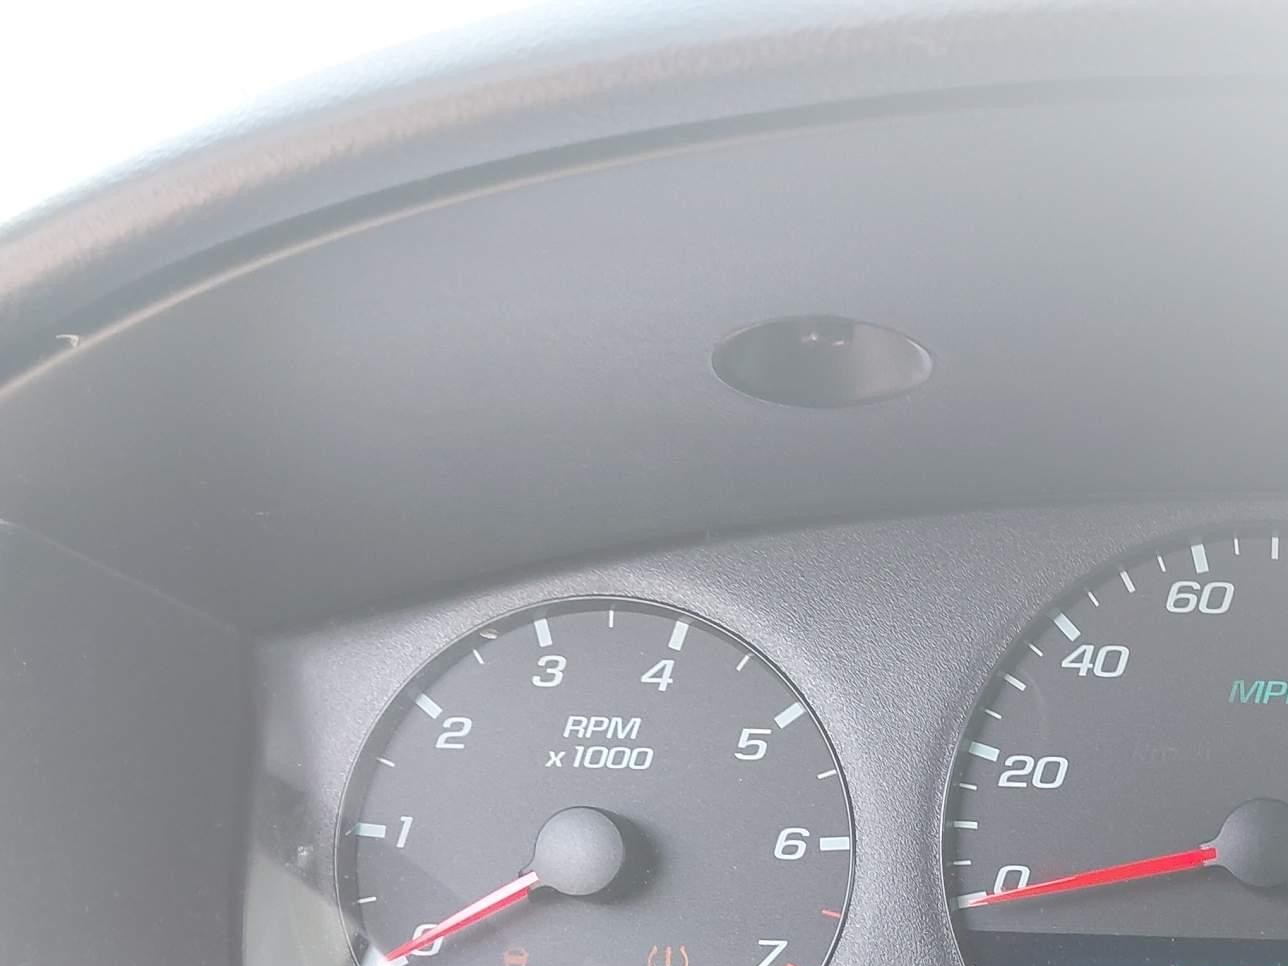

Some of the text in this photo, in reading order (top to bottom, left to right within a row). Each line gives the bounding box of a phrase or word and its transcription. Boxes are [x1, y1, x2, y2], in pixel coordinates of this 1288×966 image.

[1166, 581, 1235, 614] 60
[531, 655, 568, 688] 3
[640, 659, 675, 692] 4
[1061, 644, 1130, 678] 40
[435, 716, 473, 749] 2
[562, 716, 642, 739] RPM
[545, 747, 654, 769] x 1000
[734, 728, 773, 761] 5
[998, 756, 1069, 788] 20
[396, 816, 413, 848] 1
[773, 828, 811, 860] 6
[993, 865, 1030, 893] 0
[411, 924, 444, 956] 0
